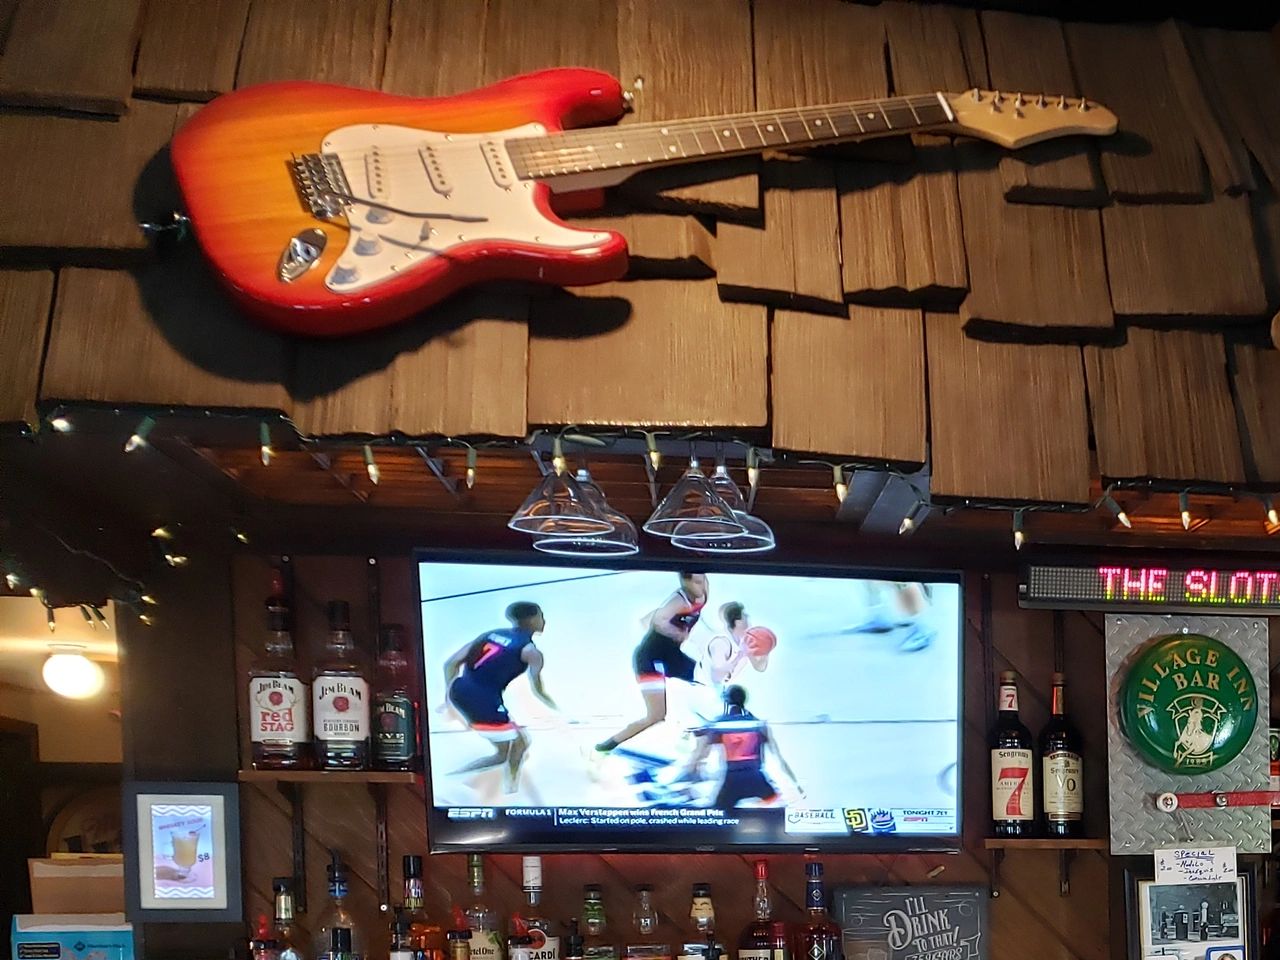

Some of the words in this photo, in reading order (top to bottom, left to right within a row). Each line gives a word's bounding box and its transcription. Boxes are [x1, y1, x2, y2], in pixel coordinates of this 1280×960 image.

[1099, 568, 1167, 600] THE
[1137, 649, 1220, 718] VILLAGE
[1226, 666, 1253, 711] INN
[1172, 671, 1220, 691] BAR
[319, 685, 335, 700] JIM
[337, 683, 362, 700] BEAM
[1006, 694, 1015, 708] 7
[260, 708, 292, 722] red
[260, 722, 294, 732] STAG
[323, 723, 360, 732] BOURBON
[998, 767, 1029, 815] 7
[448, 808, 494, 818] ESPN
[559, 808, 578, 816] Max
[579, 808, 629, 818] Verstappen
[650, 808, 679, 816] French
[680, 808, 706, 816] Grand
[706, 808, 724, 816] Prix
[697, 817, 723, 825] leading
[197, 853, 210, 862] $8
[905, 897, 929, 915] I'LL
[883, 908, 951, 950] DRINK
[912, 938, 927, 952] TO
[928, 926, 960, 951] THAT!
